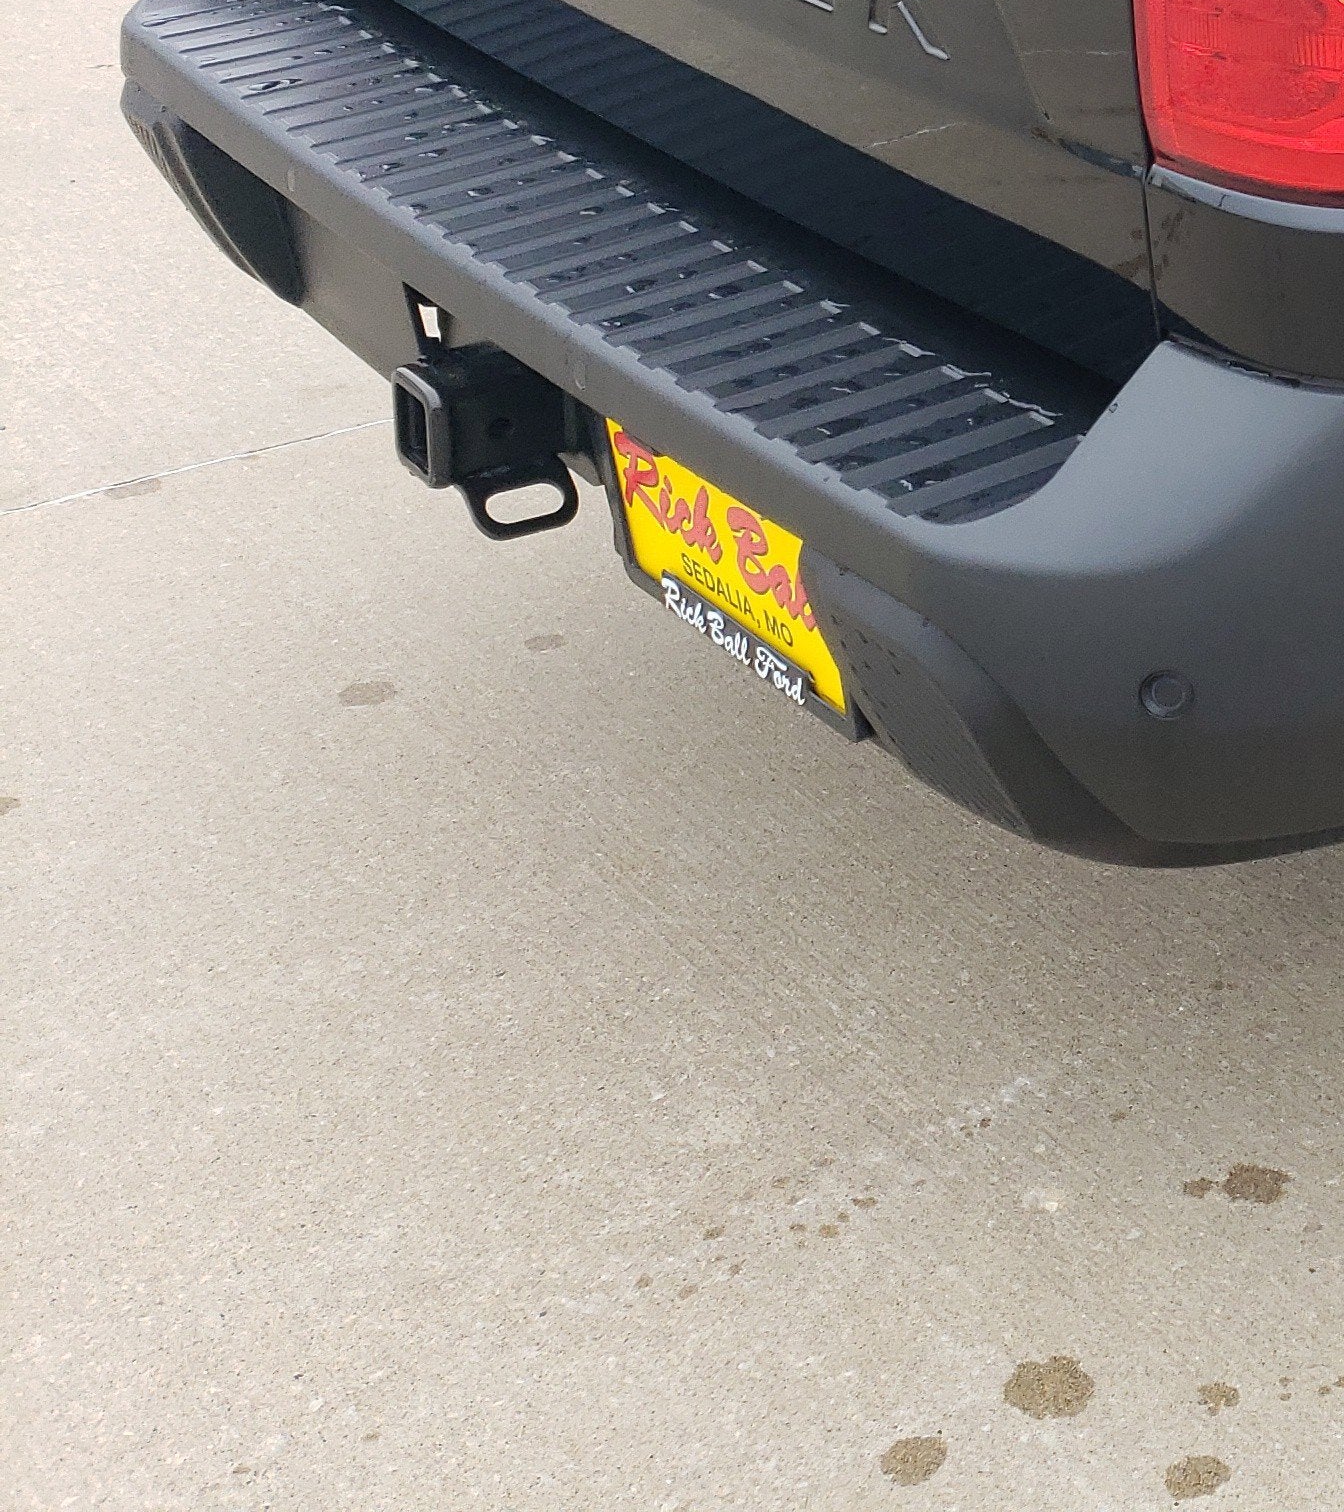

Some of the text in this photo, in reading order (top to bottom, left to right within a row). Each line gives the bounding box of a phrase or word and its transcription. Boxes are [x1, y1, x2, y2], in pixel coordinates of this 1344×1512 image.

[614, 431, 723, 564] Rick
[661, 577, 806, 706] Rick Ball Ford
[680, 552, 794, 648] SEDALIA, MO
